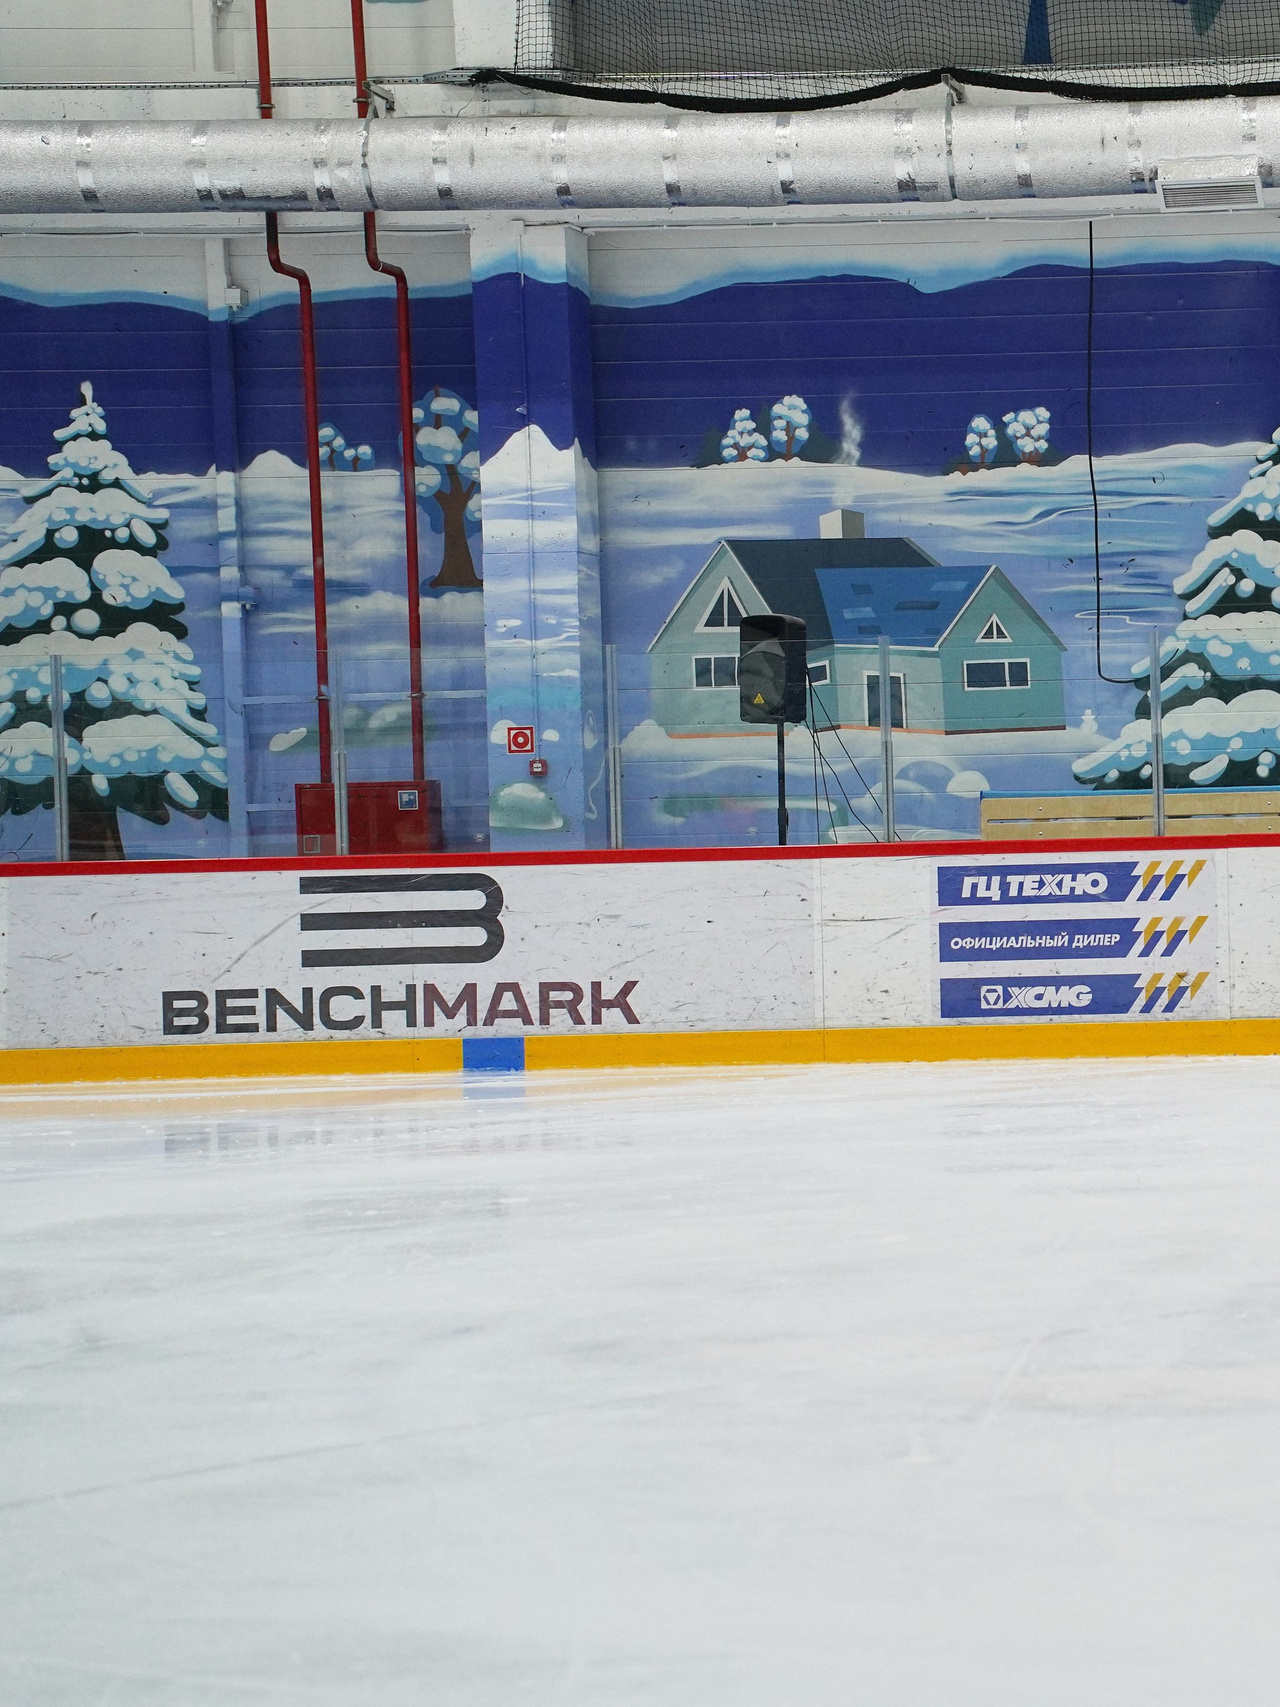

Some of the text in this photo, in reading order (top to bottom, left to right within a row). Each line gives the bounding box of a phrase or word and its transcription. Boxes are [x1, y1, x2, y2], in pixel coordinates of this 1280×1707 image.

[962, 873, 1109, 901] ГЦ ТЕХНО
[951, 932, 1121, 950] ОФИЦИАЛЬНЫЙ ДИЛЕР
[162, 981, 640, 1036] BENCHMARK
[1002, 985, 1094, 1010] XCMG
